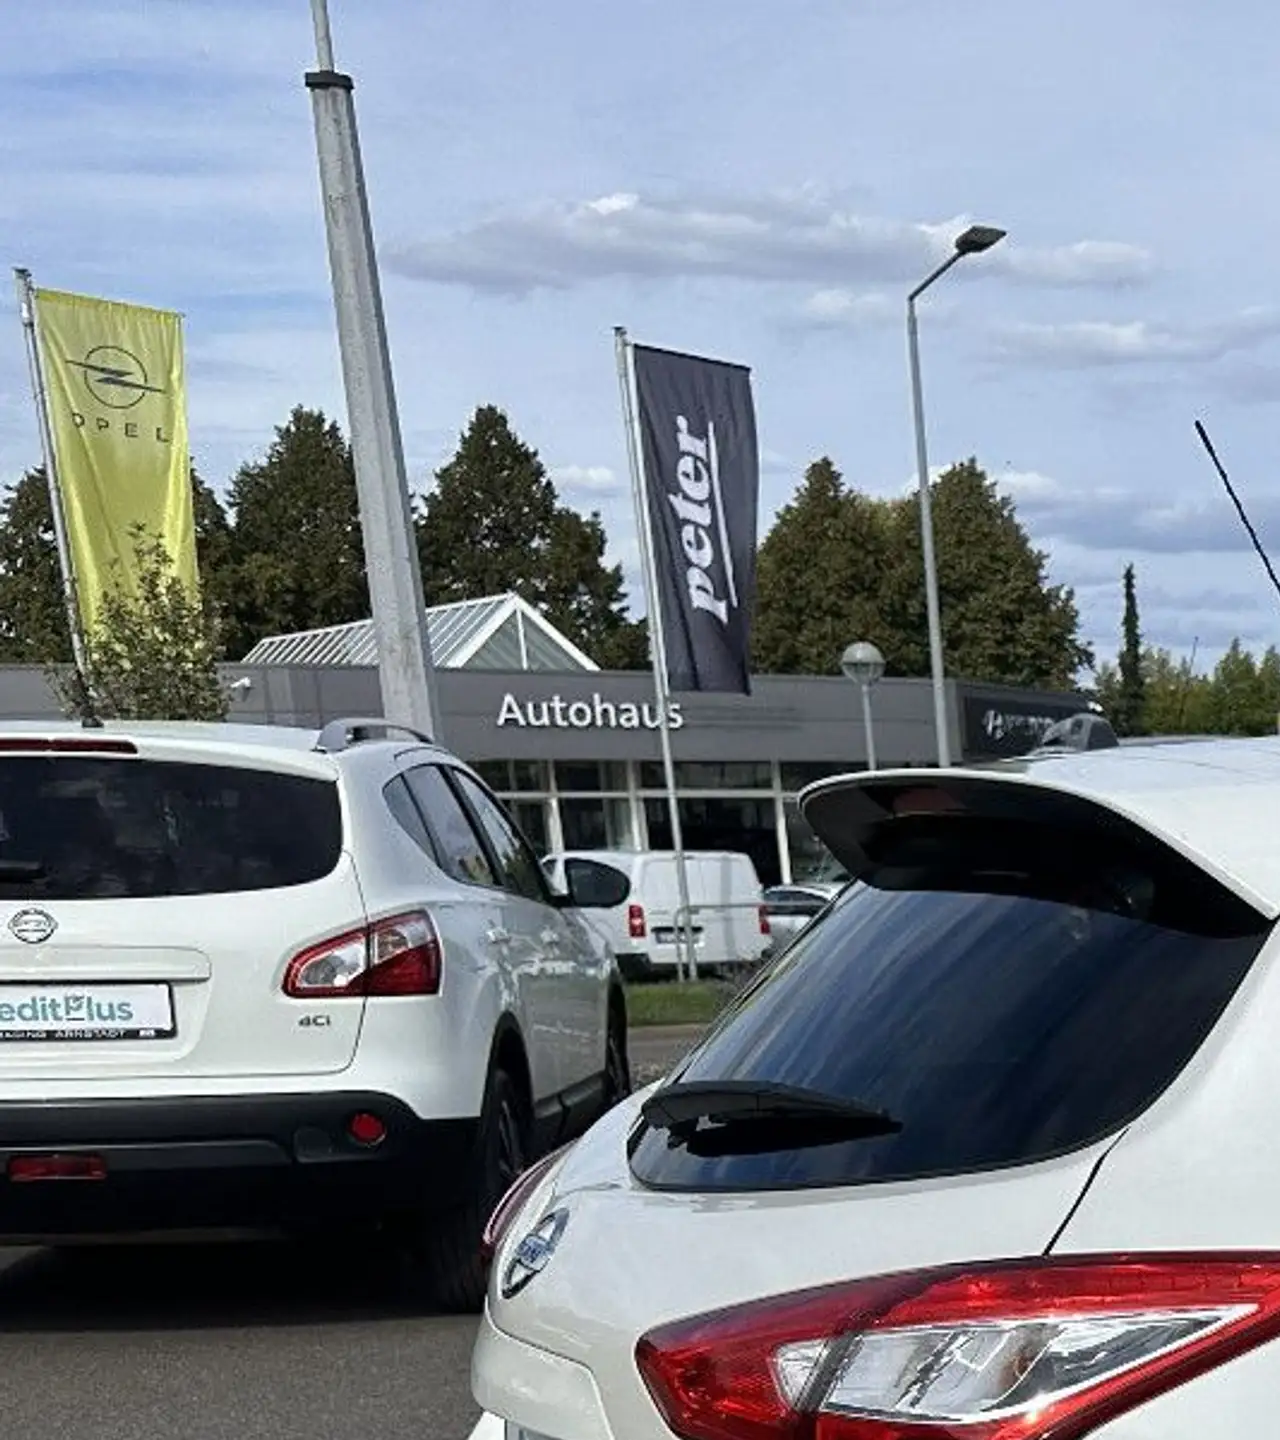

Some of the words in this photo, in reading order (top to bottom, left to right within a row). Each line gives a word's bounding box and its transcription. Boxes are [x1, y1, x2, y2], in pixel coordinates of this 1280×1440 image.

[72, 412, 170, 443] OPEL
[667, 414, 730, 625] peter
[496, 692, 684, 729] Autohaus
